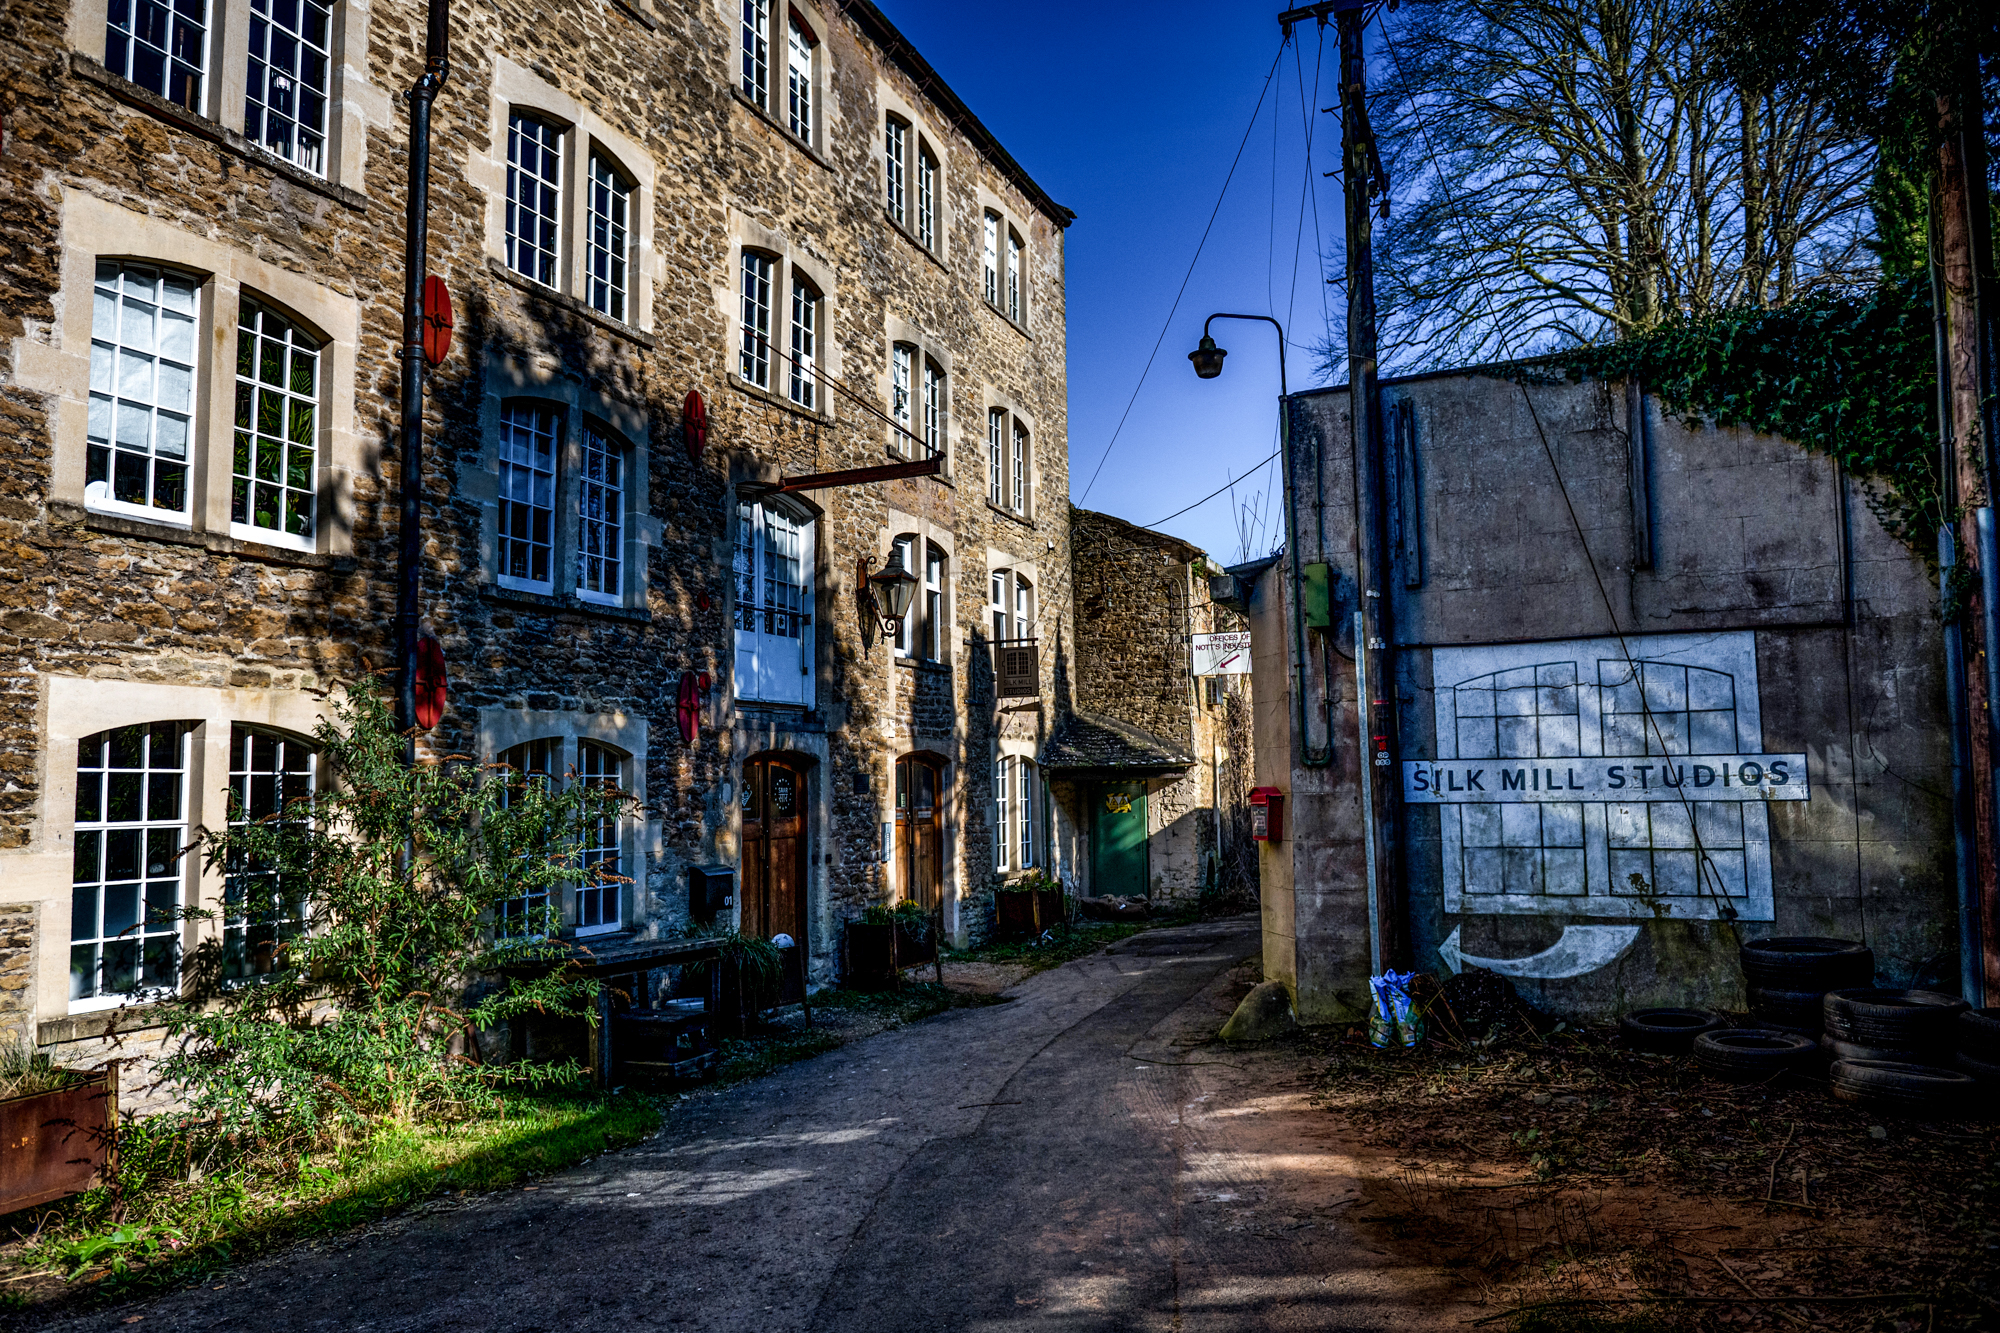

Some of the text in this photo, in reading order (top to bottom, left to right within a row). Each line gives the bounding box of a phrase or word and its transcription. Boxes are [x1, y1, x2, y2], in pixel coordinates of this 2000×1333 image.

[1209, 633, 1251, 642] OFFICES OF
[1413, 759, 1790, 792] SILK MILL STUDIOS
[724, 896, 733, 906] 01
